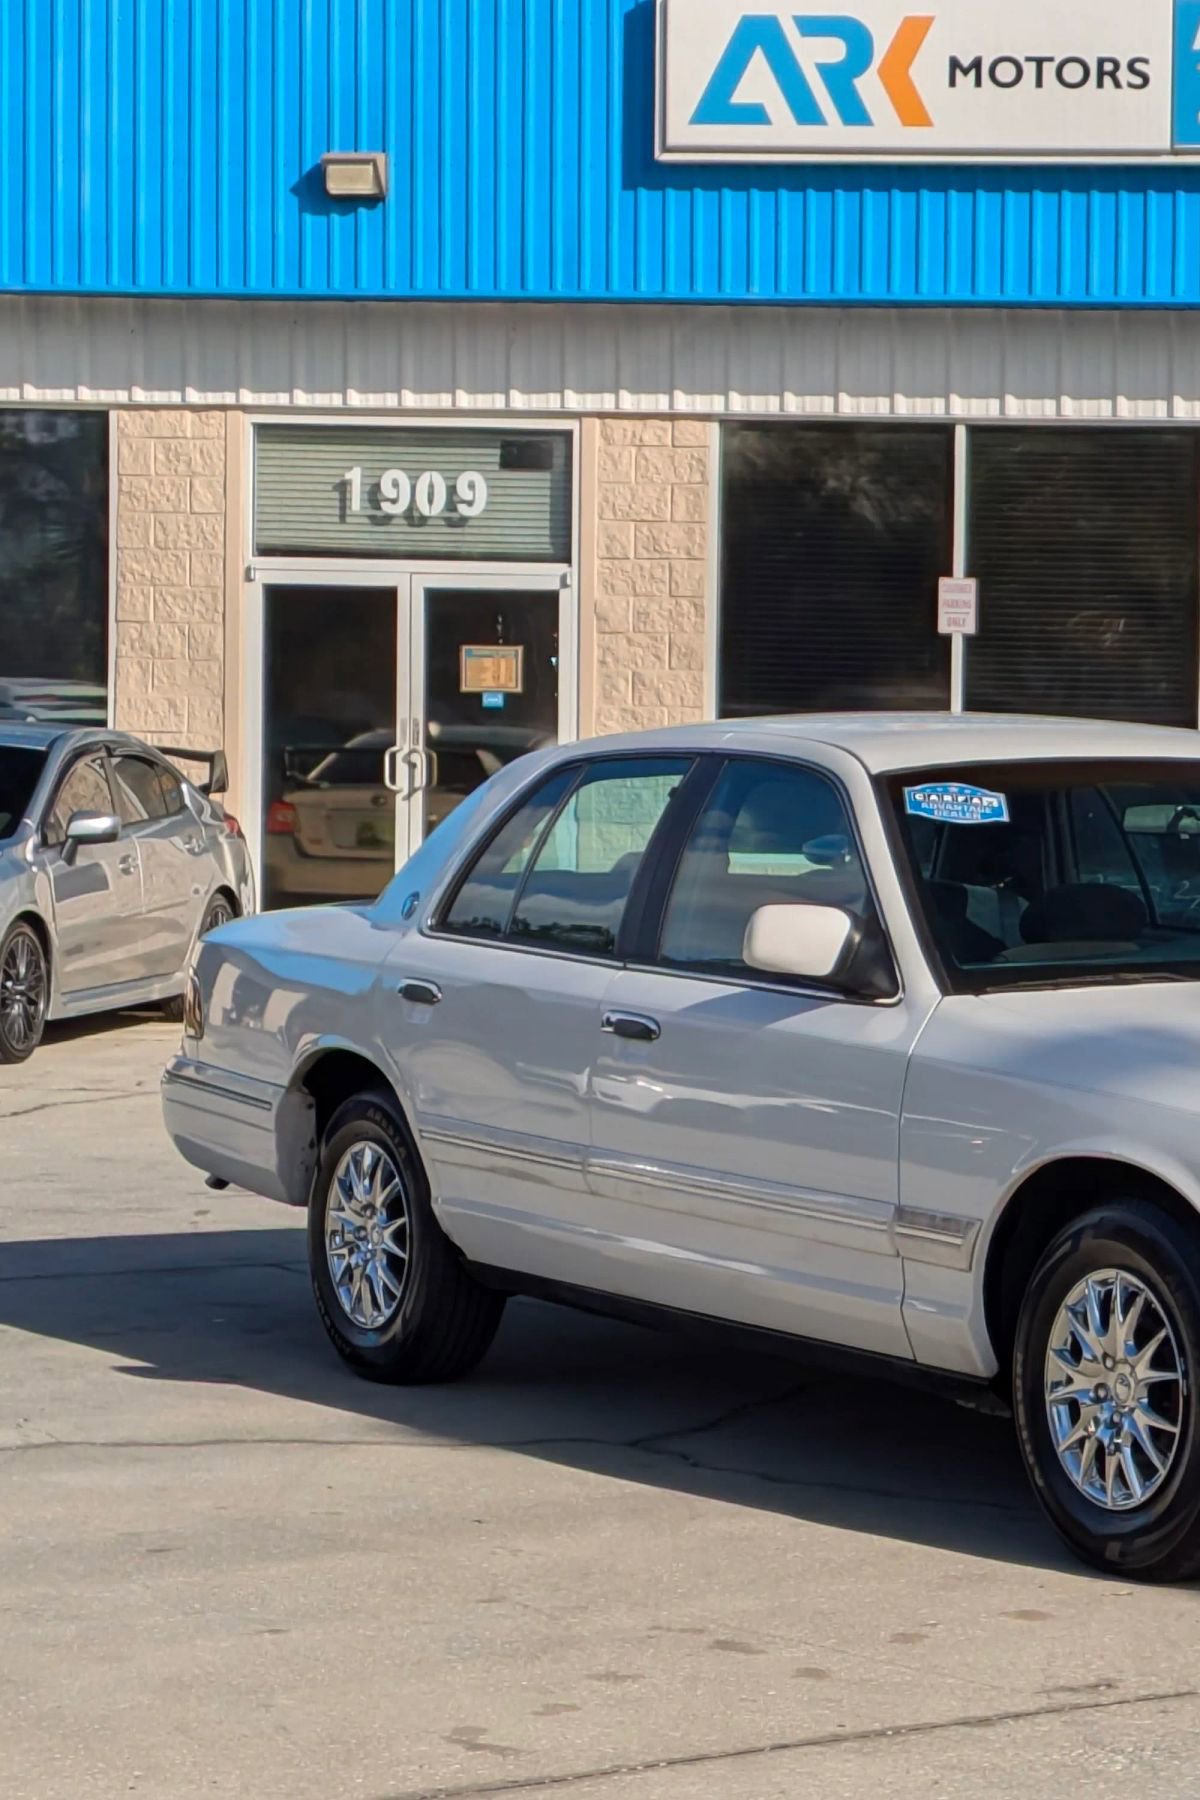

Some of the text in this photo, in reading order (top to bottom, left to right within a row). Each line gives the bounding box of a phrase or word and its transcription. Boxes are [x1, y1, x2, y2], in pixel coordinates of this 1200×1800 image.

[688, 14, 1151, 127] ARK MOTORS
[344, 466, 487, 517] 1909
[912, 791, 999, 808] CARFAX
